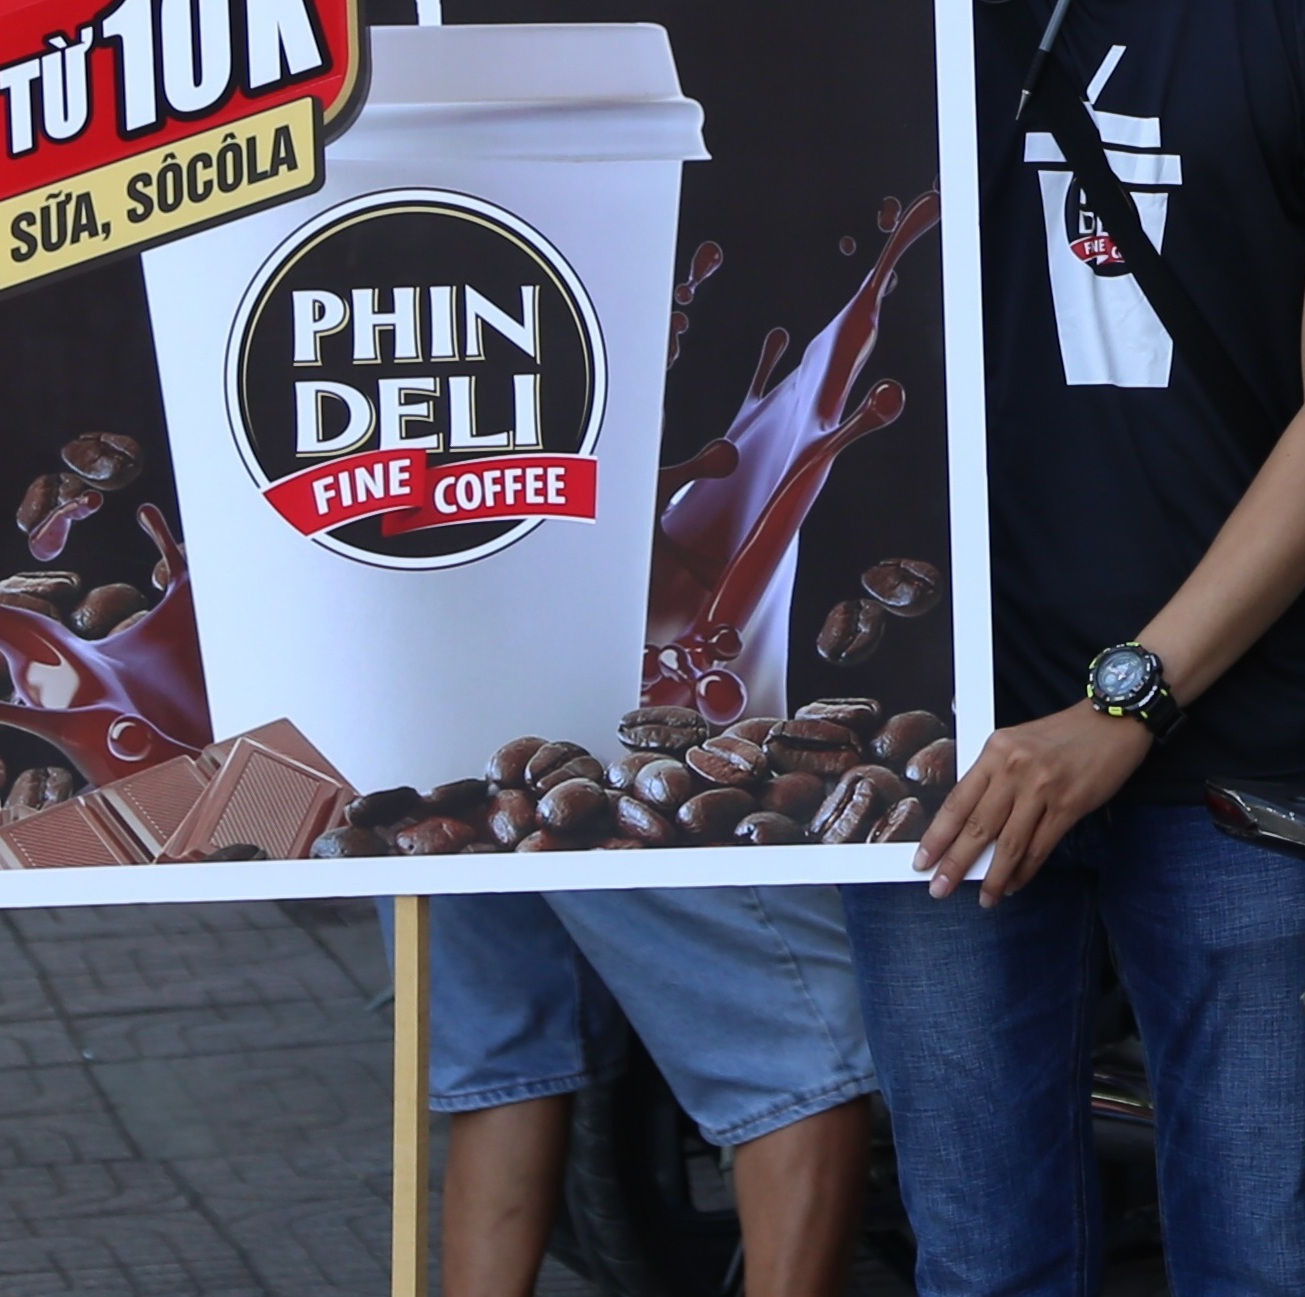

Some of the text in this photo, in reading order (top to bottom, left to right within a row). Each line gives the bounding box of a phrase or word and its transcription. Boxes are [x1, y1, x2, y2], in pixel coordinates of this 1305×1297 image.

[10, 188, 112, 262] SỮA,
[125, 124, 298, 224] SÔCÔLA
[292, 283, 542, 367] PHIN
[294, 373, 544, 458] DELI
[311, 458, 567, 516] FINE COFFEE
